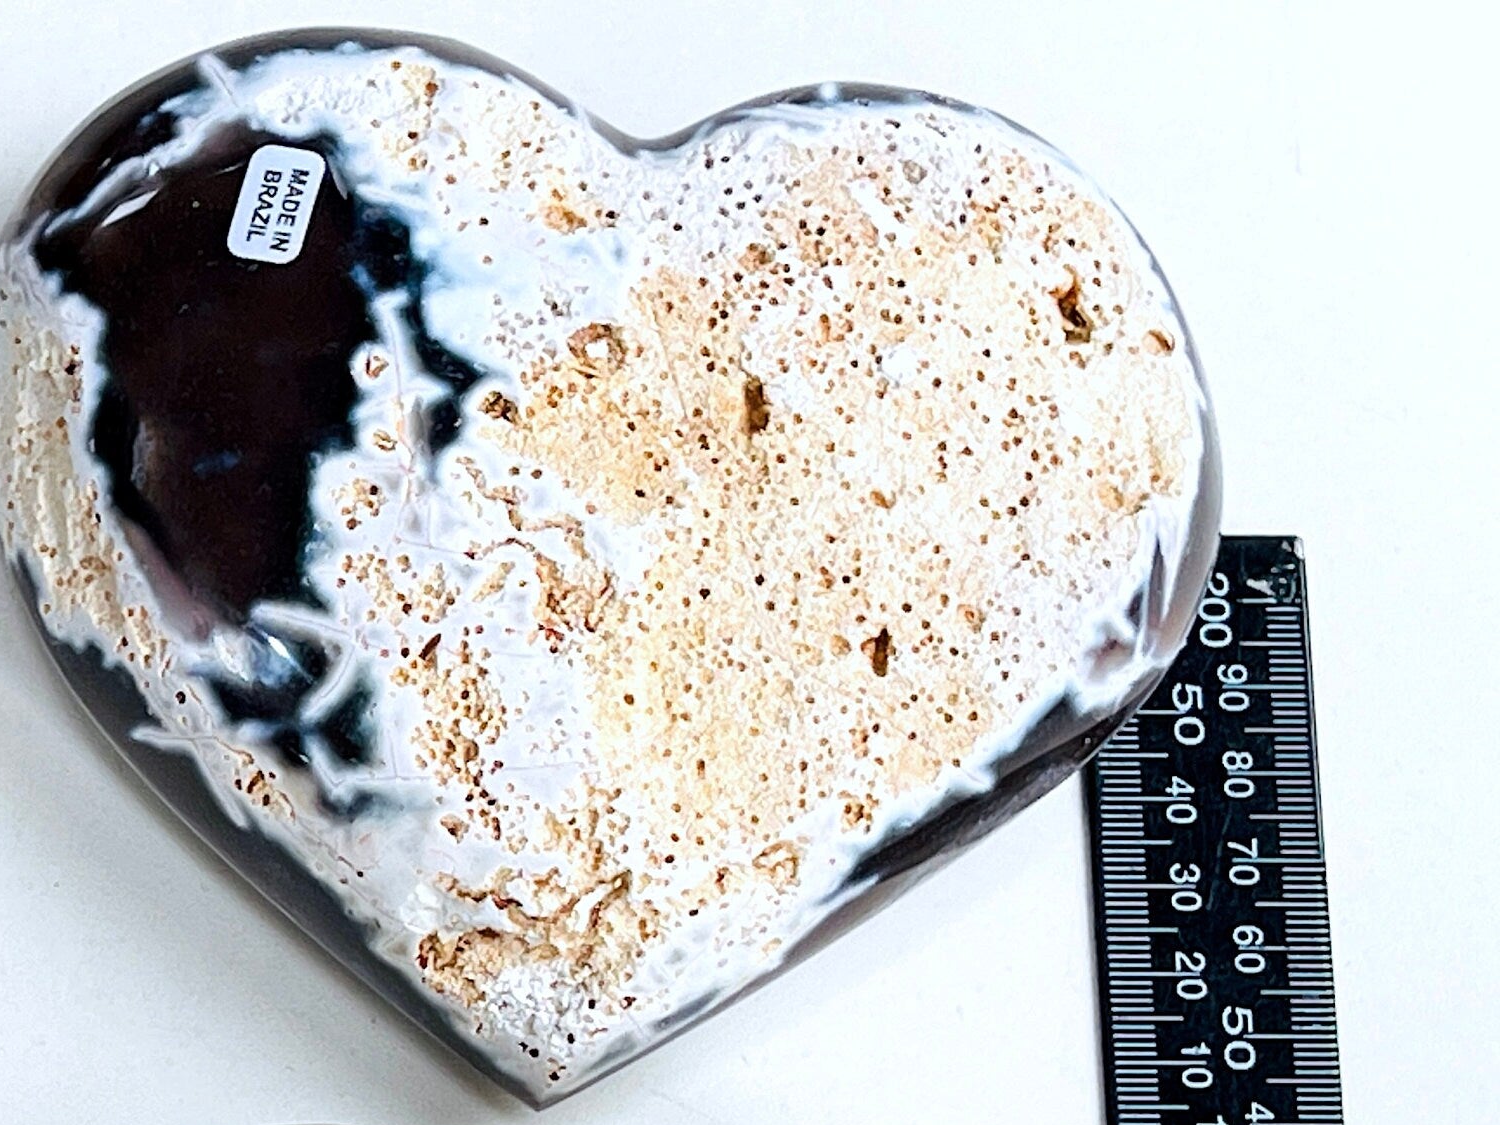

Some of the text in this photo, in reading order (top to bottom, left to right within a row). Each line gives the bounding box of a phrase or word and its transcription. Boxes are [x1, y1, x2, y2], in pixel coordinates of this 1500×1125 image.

[246, 170, 282, 242] BRAZIL
[269, 168, 310, 252] MADE IN
[1198, 572, 1233, 648] 200
[1217, 664, 1250, 712] 90
[1172, 683, 1205, 745] 50
[1222, 750, 1255, 799] 80
[1165, 776, 1197, 824] 40
[1227, 838, 1260, 886] 70
[1169, 863, 1202, 912] 30
[1232, 925, 1266, 974] 60
[1174, 952, 1207, 1000] 20
[1222, 1005, 1256, 1070] 50
[1180, 1042, 1213, 1089] 10
